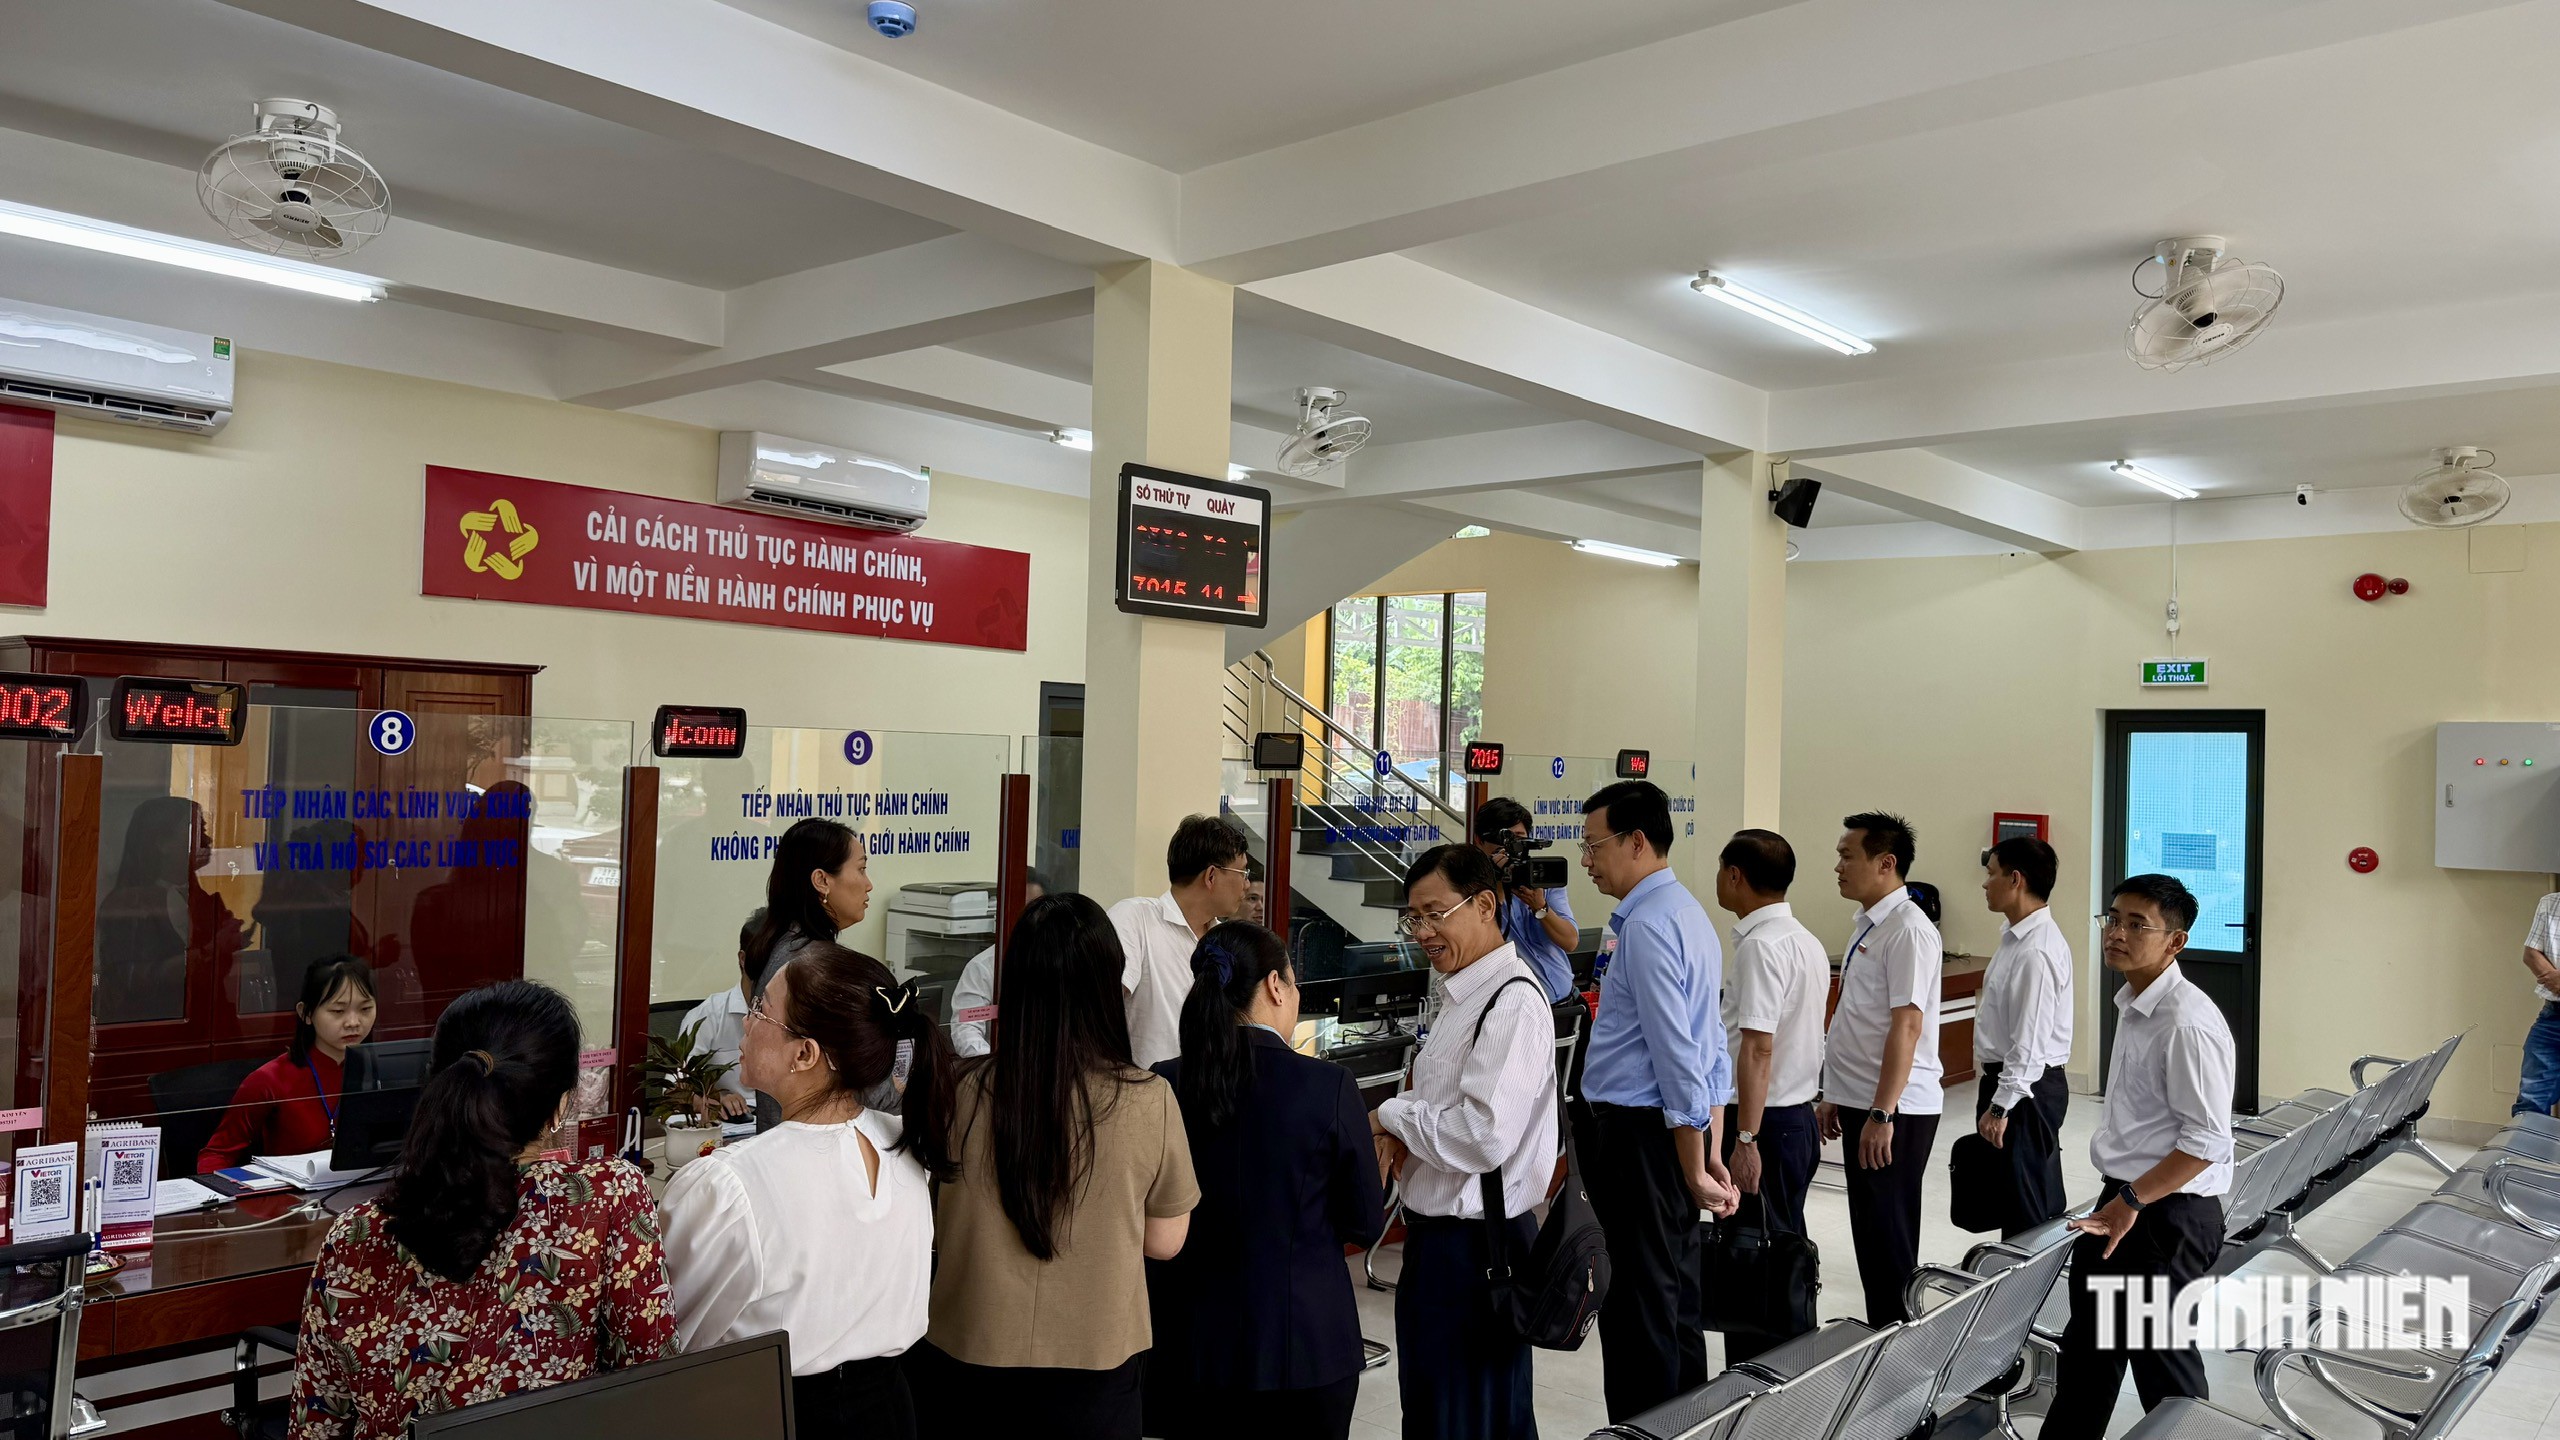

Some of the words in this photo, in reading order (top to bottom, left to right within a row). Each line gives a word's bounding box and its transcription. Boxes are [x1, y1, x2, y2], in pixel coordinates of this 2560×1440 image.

[587, 505, 626, 544] CẢI
[635, 514, 698, 553] CÁCH
[705, 524, 748, 560] THỦ
[756, 535, 796, 569] TỤC
[803, 537, 857, 574] HÀNH
[863, 548, 927, 587] CHÍNH,
[573, 555, 598, 592] VÌ
[606, 560, 658, 603] MỘT
[666, 564, 709, 604] NỀN
[718, 574, 776, 610] HÀNH
[783, 583, 846, 618] CHÍNH
[853, 593, 904, 629] PHỤC
[910, 600, 934, 633] VỤ
[2156, 663, 2191, 672] EXIT
[2168, 673, 2195, 682] THOÁT
[381, 716, 403, 749] 8
[852, 736, 865, 759] 9
[1471, 748, 1499, 768] 7015
[1378, 755, 1390, 772] 11
[1553, 760, 1563, 775] 12
[240, 782, 287, 819] TIẾP
[293, 784, 347, 824] NHẬN
[353, 784, 391, 819] CÁC
[398, 785, 439, 819] LĨNH
[445, 790, 481, 824] VỰC
[487, 786, 532, 819] KHÁC
[742, 785, 772, 817] TIẾP
[776, 788, 813, 820] NHẬN
[817, 786, 842, 817] THỦ
[846, 793, 870, 820] TỤC
[875, 788, 908, 816] HÀNH
[912, 788, 948, 815] CHÍNH
[288, 835, 325, 871] TRẢ
[364, 838, 389, 870] SƠ
[395, 835, 431, 868] CÁC
[711, 830, 759, 861] KHÔNG
[764, 835, 781, 860] PH
[869, 827, 894, 855] GIỚI
[899, 827, 931, 854] HÀNH
[934, 826, 970, 853] CHÍNH
[110, 1139, 158, 1148] AGRIBANK
[26, 1154, 74, 1166] AGRIBANK
